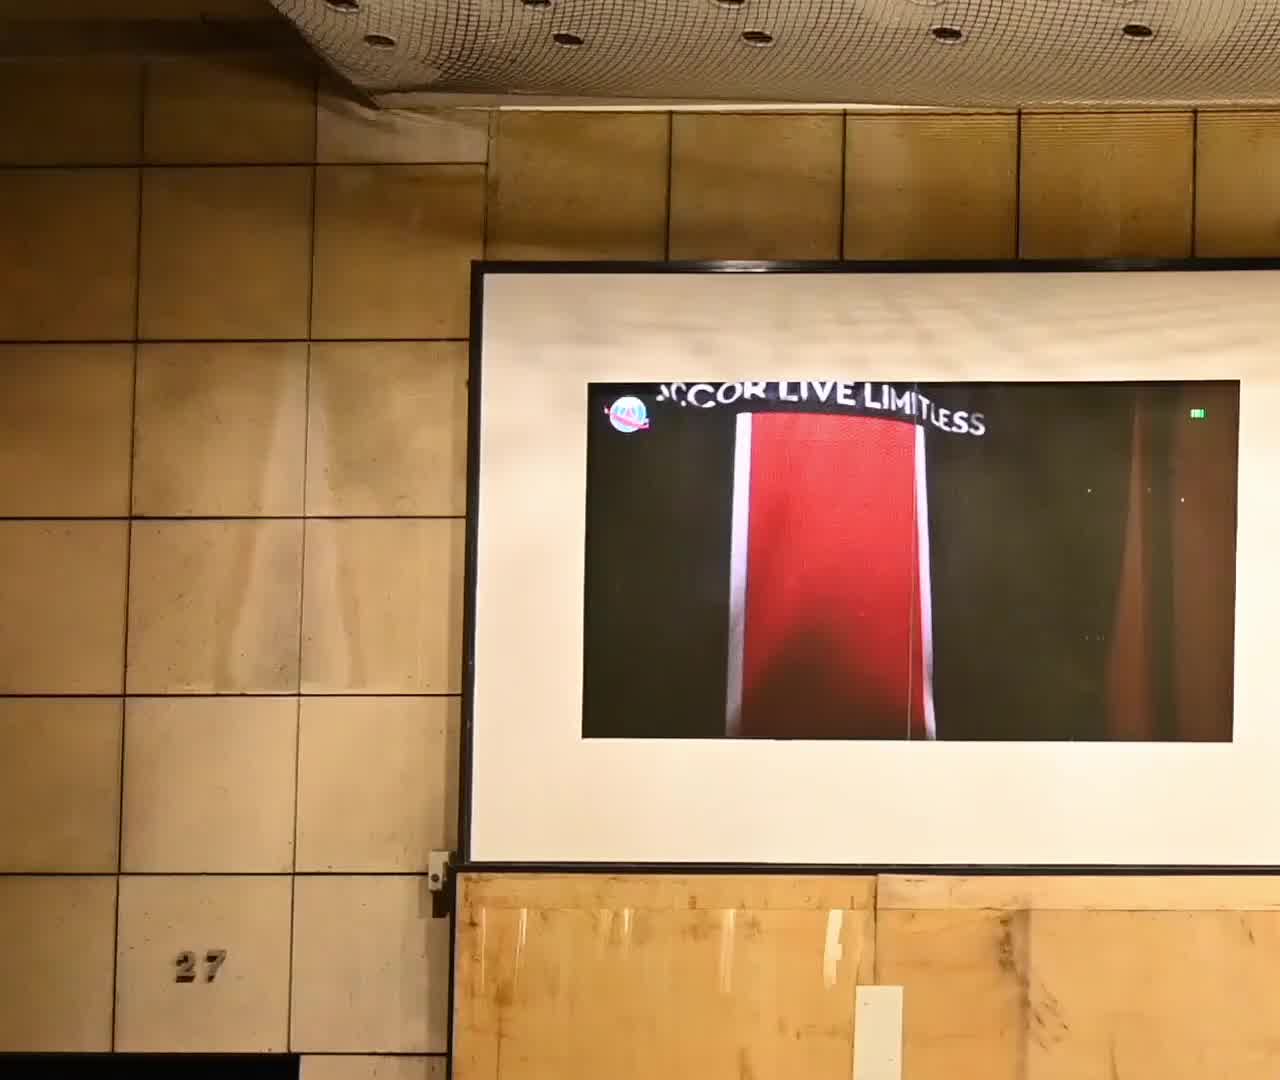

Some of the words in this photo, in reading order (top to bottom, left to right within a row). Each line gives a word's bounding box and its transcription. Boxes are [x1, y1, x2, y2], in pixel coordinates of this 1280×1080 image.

[778, 382, 856, 405] LIVE
[864, 383, 986, 435] LIMITLESS
[175, 949, 228, 983] 27
